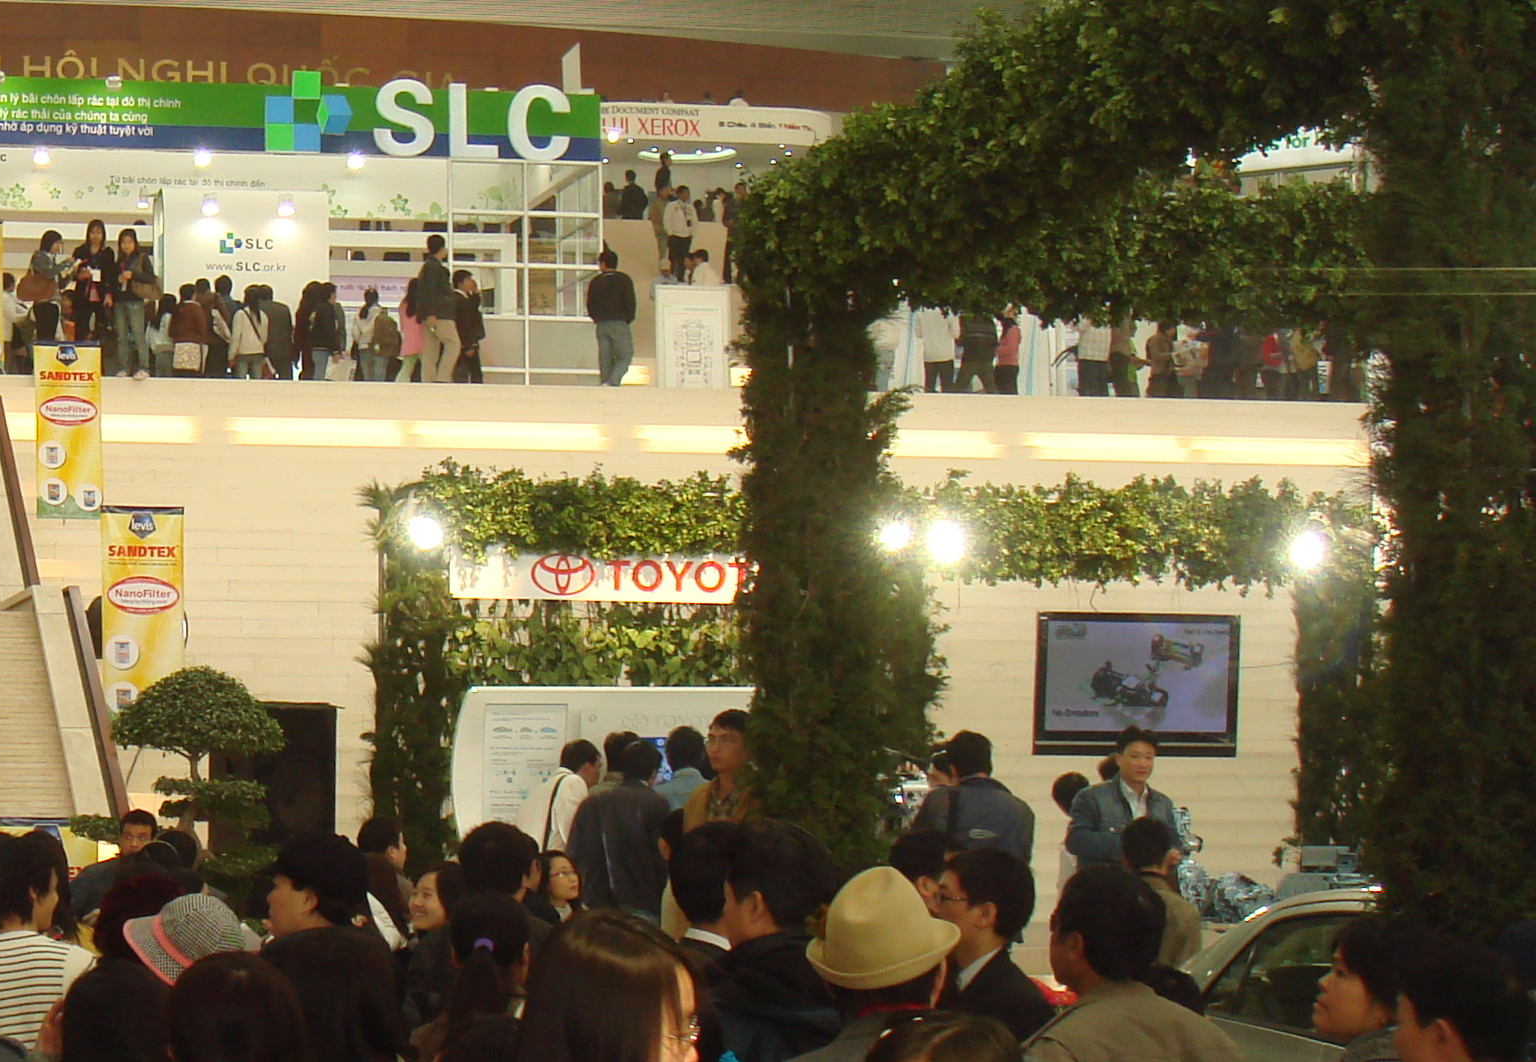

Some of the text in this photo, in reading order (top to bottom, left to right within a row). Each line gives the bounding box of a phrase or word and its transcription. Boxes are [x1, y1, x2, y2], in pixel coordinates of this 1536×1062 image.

[10, 92, 19, 105] lý
[22, 92, 37, 104] bãi
[40, 94, 65, 104] chôn
[68, 93, 84, 107] lấp
[87, 95, 104, 106] rác
[106, 96, 119, 109] tại
[137, 97, 151, 109] thị
[153, 98, 181, 109] chính
[0, 107, 9, 120] lý
[11, 109, 29, 119] rác
[31, 107, 50, 120] thải
[52, 108, 72, 120] của
[74, 110, 107, 124] chúng
[109, 111, 120, 122] ta
[373, 78, 571, 161] SLC
[20, 122, 34, 134] áp
[36, 123, 63, 135] dụng
[80, 124, 107, 136] thuật
[109, 125, 136, 138] tuyệt
[637, 117, 701, 137] XEROX
[245, 238, 274, 250] SLC
[206, 261, 287, 272] www.SLC.or.kr
[39, 370, 94, 381] SANDTEX
[45, 405, 91, 413] NanoFilter
[131, 518, 154, 531] levis
[108, 545, 176, 558] SANDTEX
[605, 559, 748, 593] TOYOT
[115, 589, 172, 598] NanoFilter
